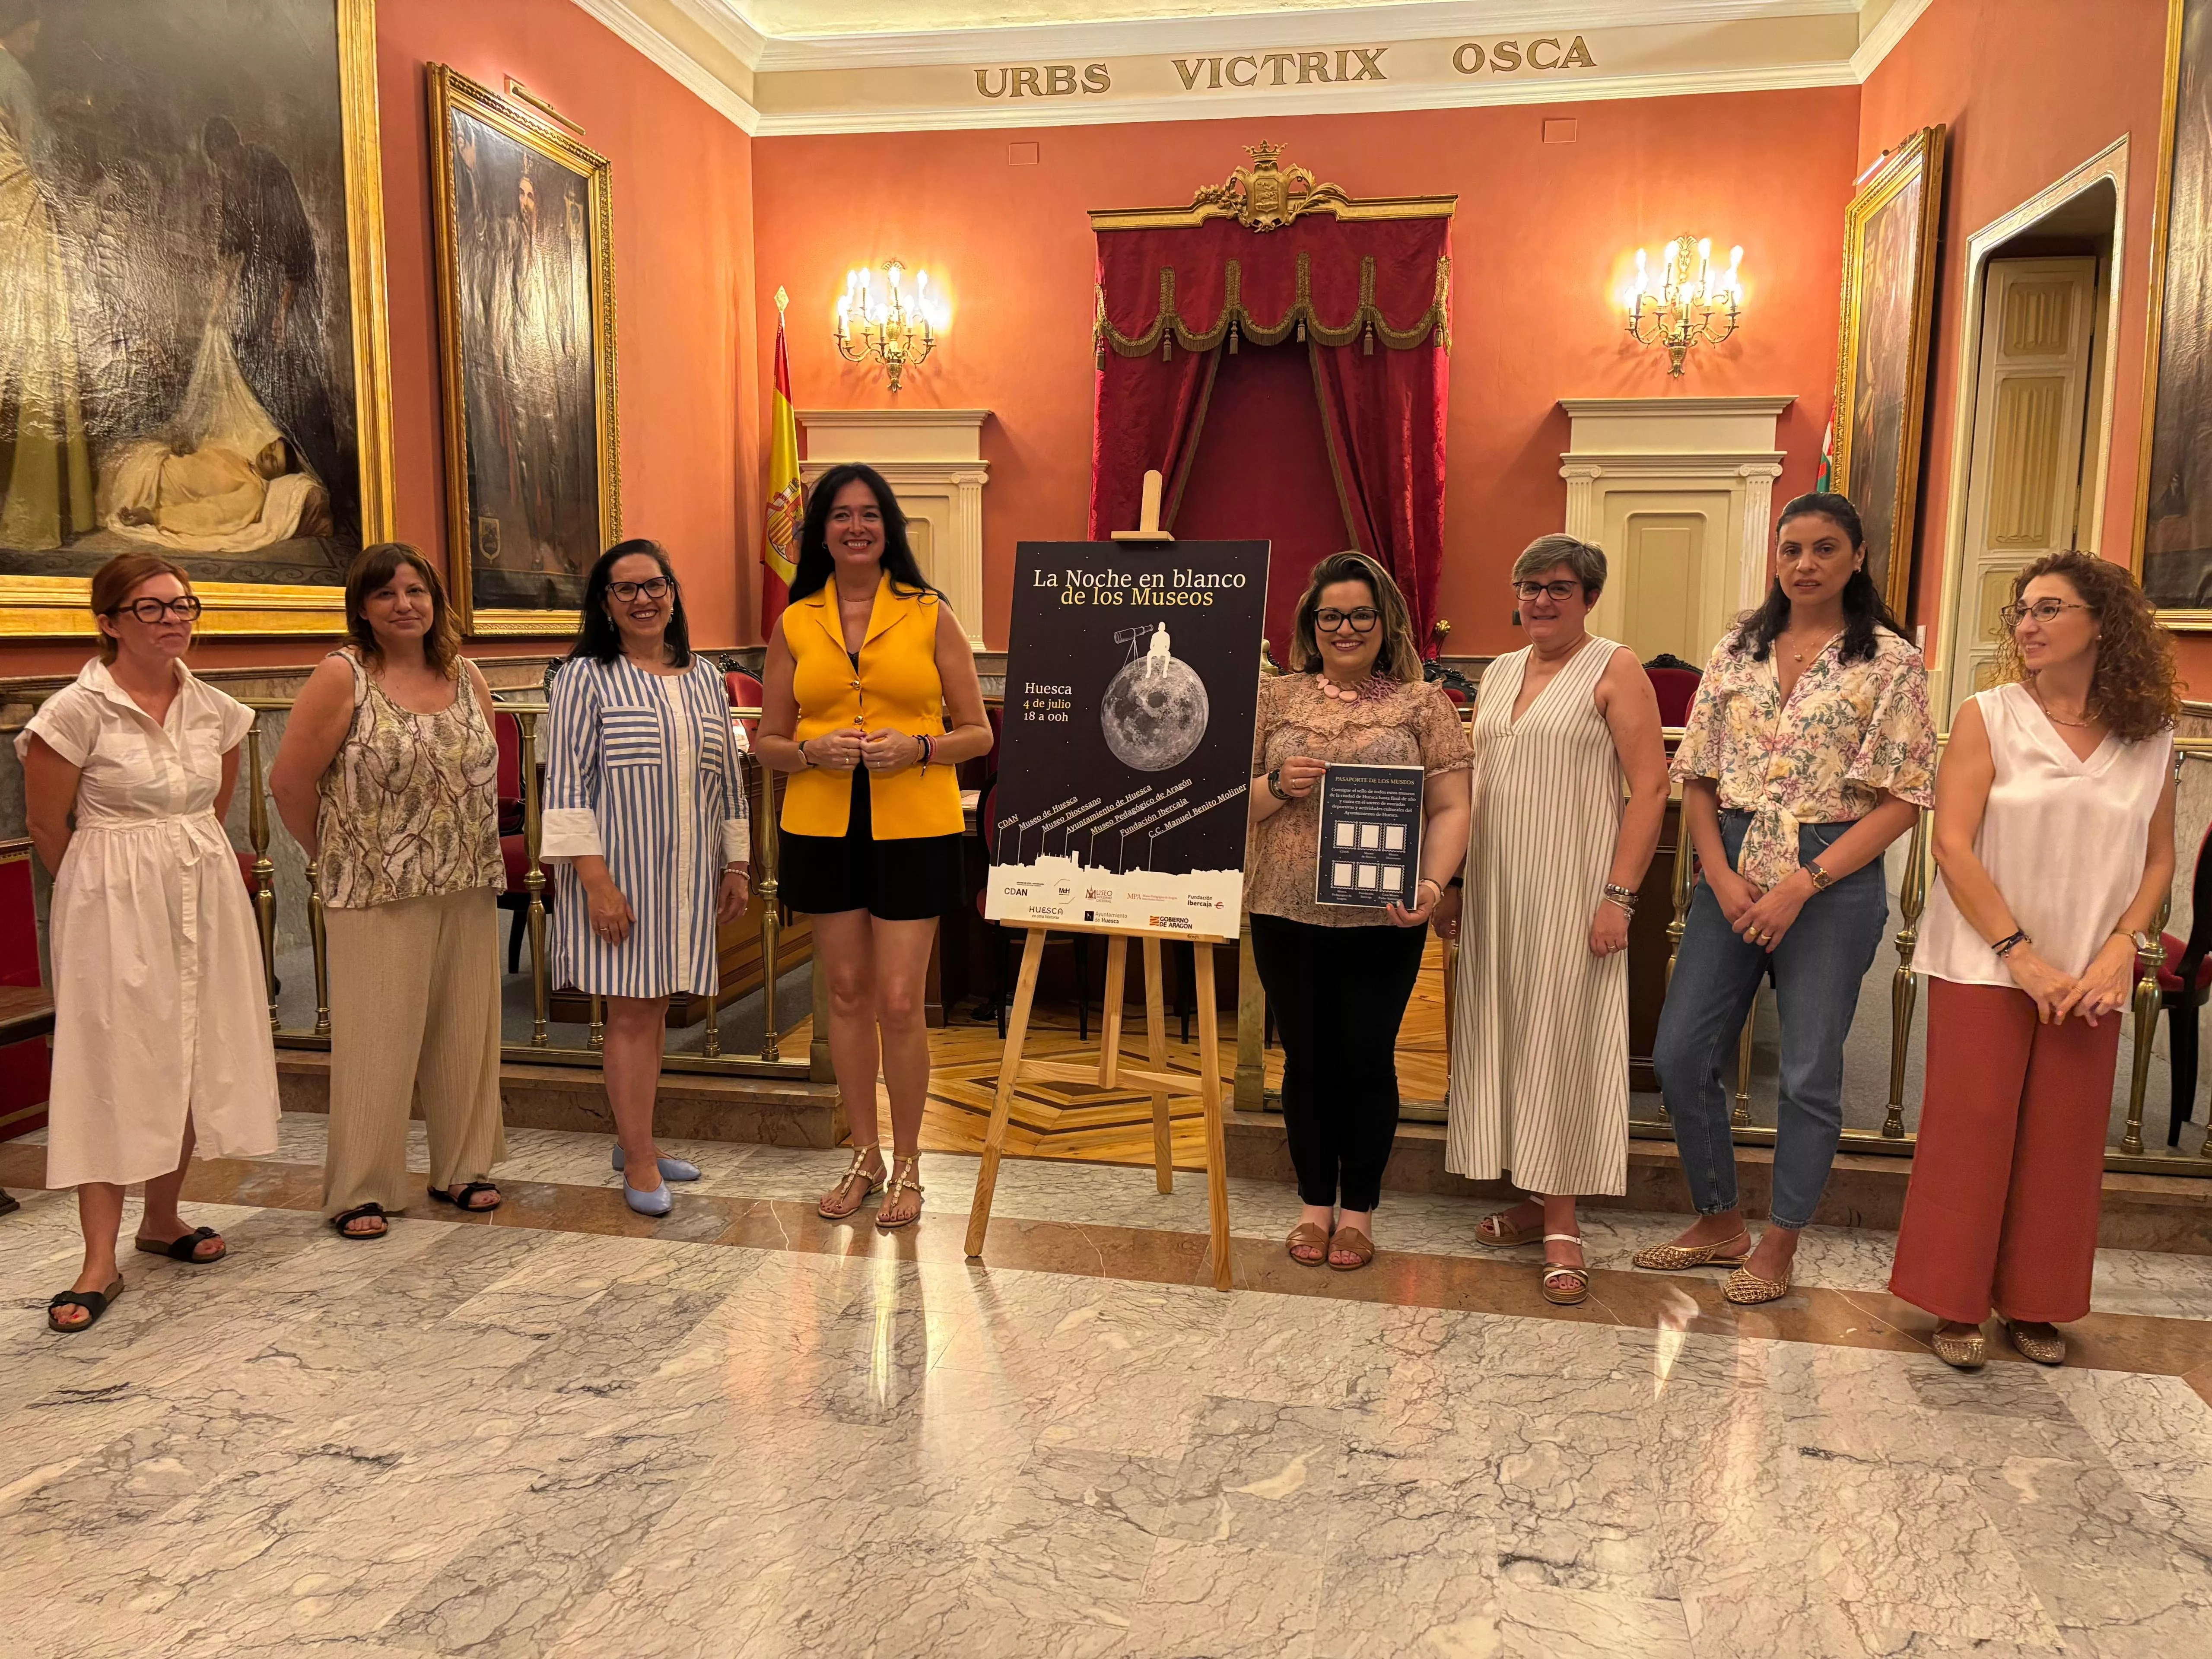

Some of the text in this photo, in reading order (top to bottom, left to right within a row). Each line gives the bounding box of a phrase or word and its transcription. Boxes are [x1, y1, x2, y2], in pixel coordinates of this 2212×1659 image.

[974, 36, 1597, 98] URBS VICTRIX OSCA
[1033, 569, 1246, 588] La Noche en blanco
[1061, 586, 1214, 606] de los Museos
[1024, 682, 1072, 695] Huesca
[1023, 698, 1071, 710] 4 de julio
[1024, 711, 1035, 721] 18
[1018, 796, 1078, 830] Museo de Huesca
[1041, 797, 1101, 832] Museo Diocesano
[1066, 785, 1152, 834] Ayuntamiento de Huesca
[1090, 778, 1192, 835] Museo Pedagógico de Aragón
[1148, 783, 1247, 838] C.C. Manuel Benito Moliner
[998, 814, 1018, 829] CDAN
[1119, 798, 1189, 836] Fundación Ibercaja
[1004, 887, 1027, 896] CDAN
[1029, 906, 1063, 915] HUESCA
[1188, 900, 1212, 908] Ibercaja
